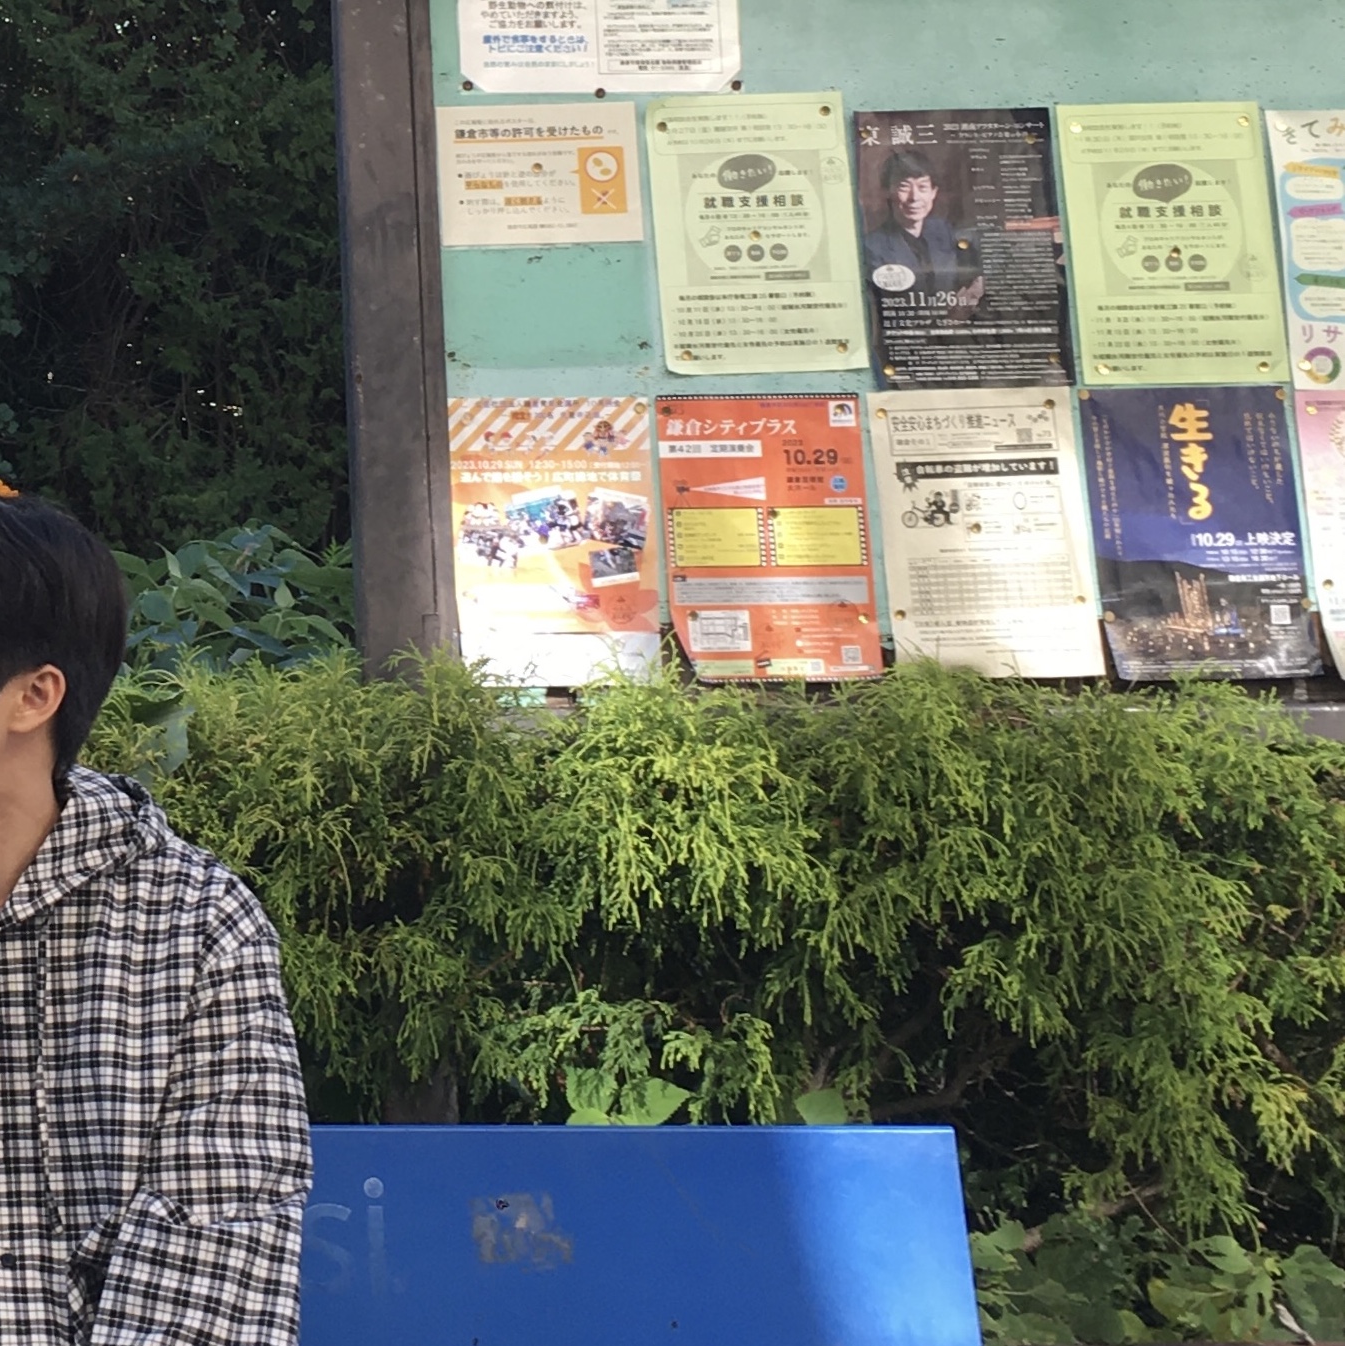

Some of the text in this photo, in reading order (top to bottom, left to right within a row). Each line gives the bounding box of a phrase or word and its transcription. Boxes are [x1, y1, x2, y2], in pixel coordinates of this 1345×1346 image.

[455, 125, 603, 140] 鎌倉市等の許可を受けたもの
[704, 193, 805, 209] 就職支援相談
[1118, 203, 1223, 219] 就職支援相談
[891, 412, 1016, 433] 安全安心まちづくり推進ニュース
[783, 448, 839, 465] 10.29
[1168, 402, 1213, 520] 生きる
[1244, 531, 1297, 547] 上映決定
